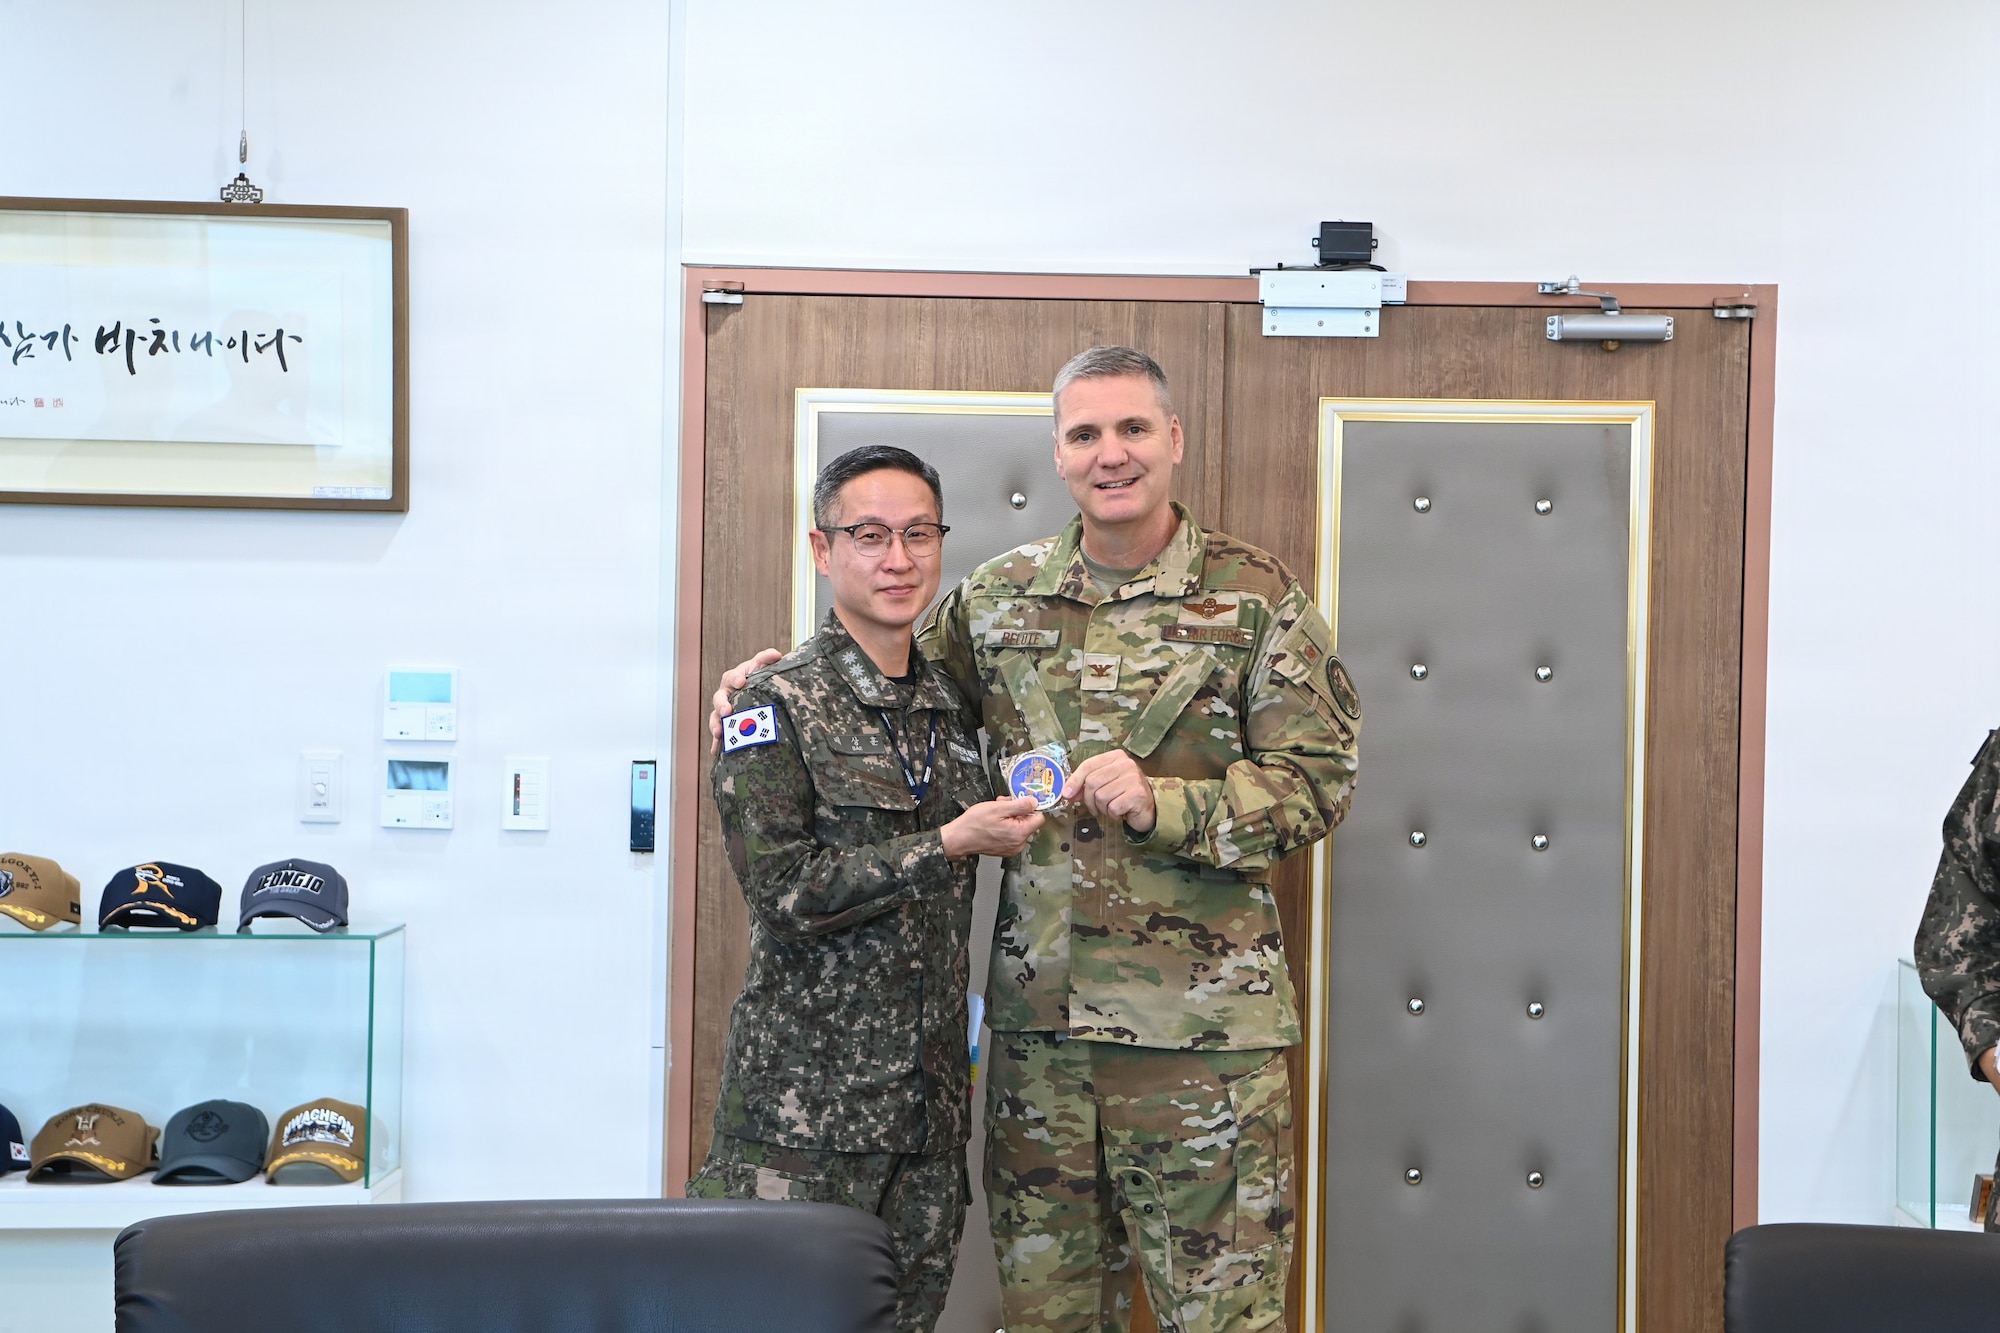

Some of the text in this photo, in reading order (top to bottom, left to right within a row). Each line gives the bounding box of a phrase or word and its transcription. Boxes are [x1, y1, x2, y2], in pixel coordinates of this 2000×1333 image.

[95, 317, 303, 376] 바치나이다
[1001, 632, 1041, 645] BELOTE
[1187, 626, 1208, 641] AIR
[1210, 627, 1250, 645] FORCE
[252, 869, 325, 896] JEONGJO
[282, 1108, 355, 1142] HWACHEON
